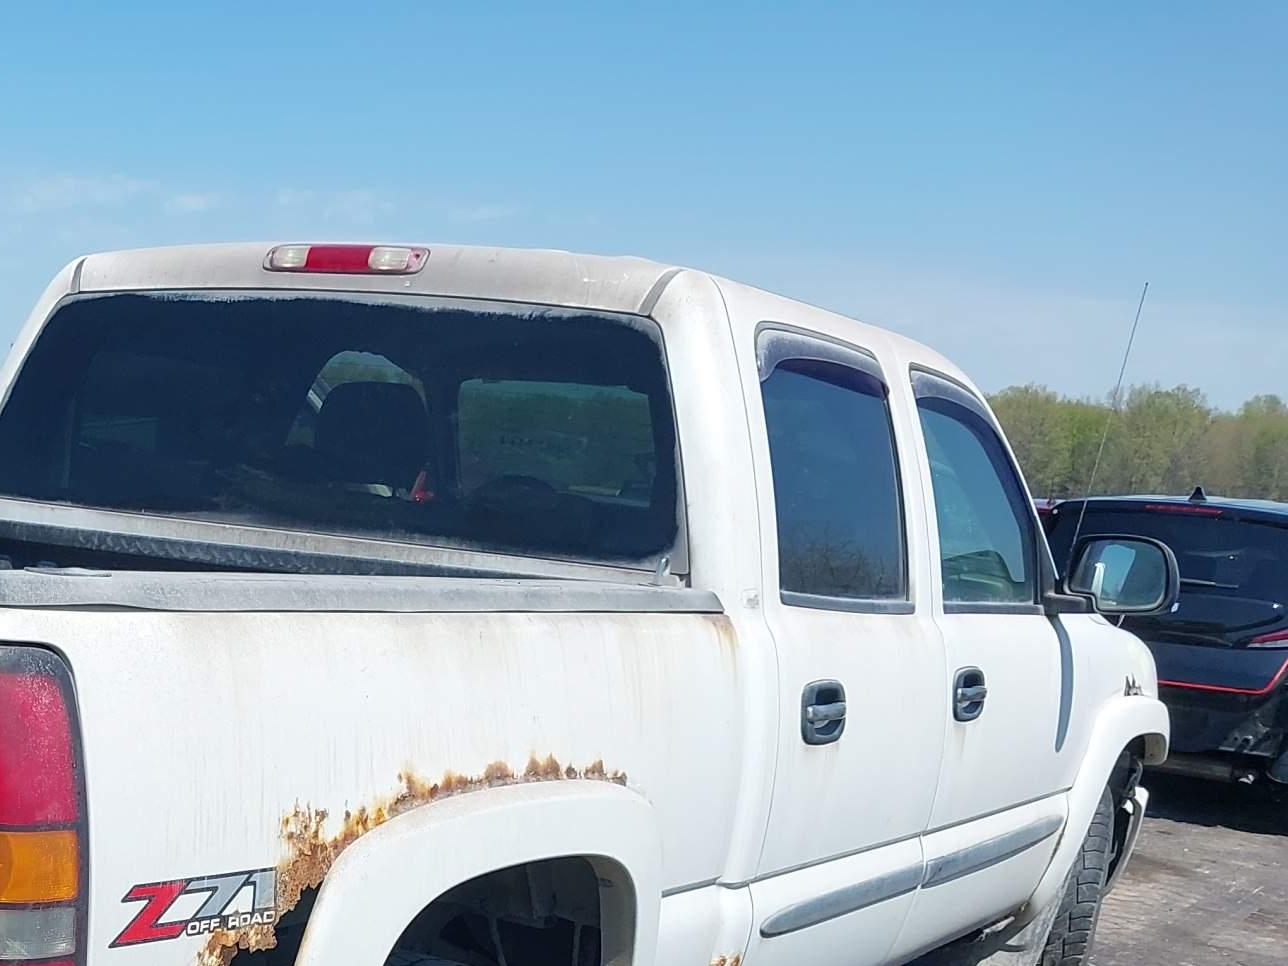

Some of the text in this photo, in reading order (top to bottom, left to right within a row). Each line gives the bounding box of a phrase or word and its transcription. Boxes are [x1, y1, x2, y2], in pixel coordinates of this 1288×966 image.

[107, 866, 278, 950] Z71
[186, 911, 276, 936] OFF ROAD
